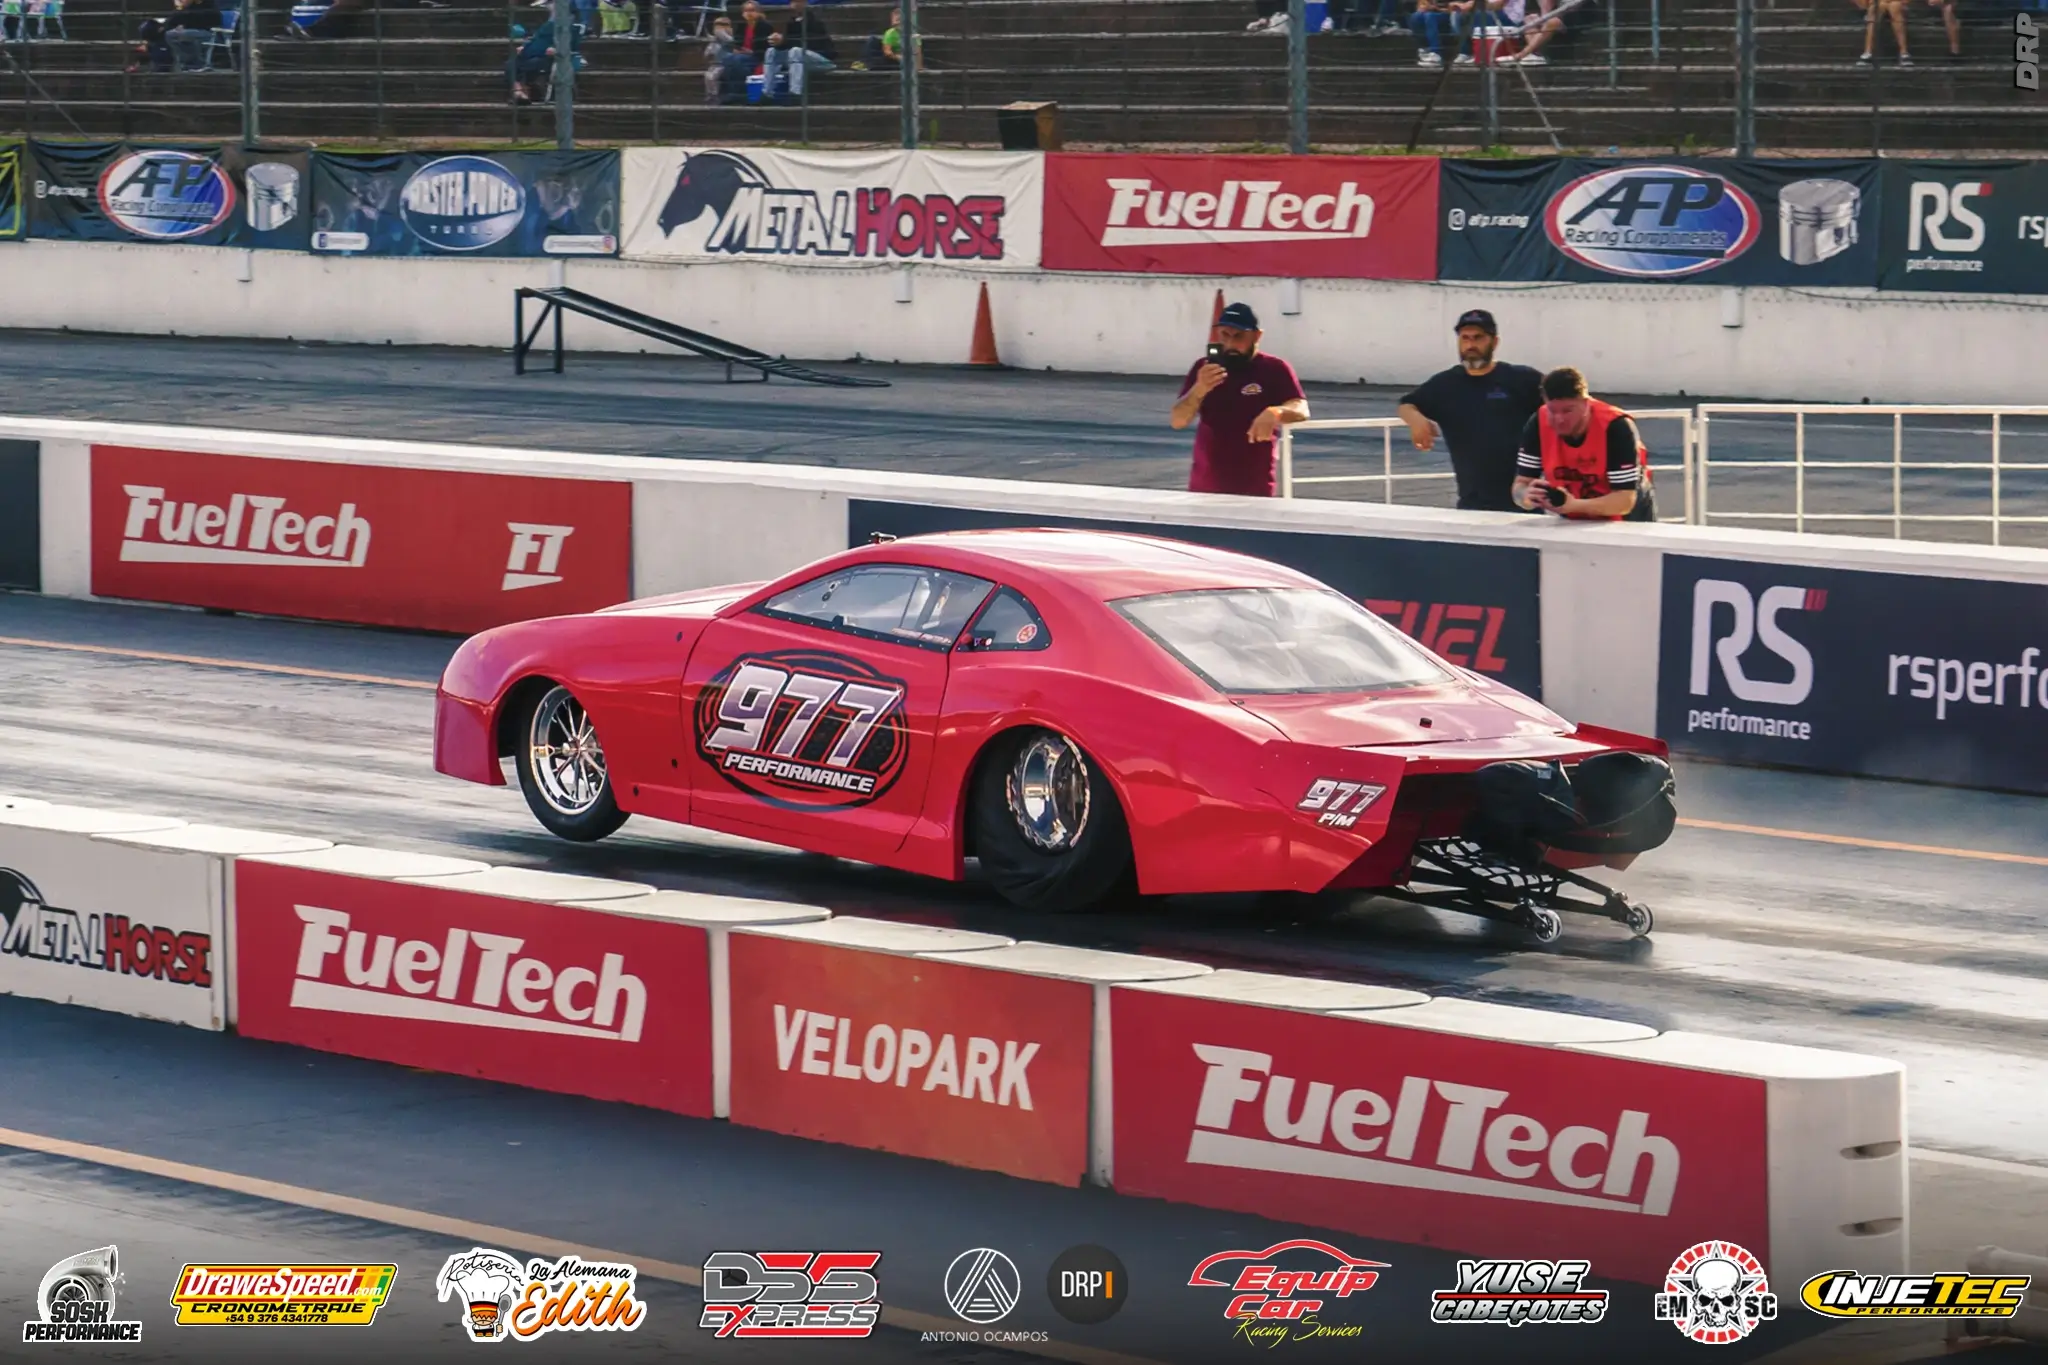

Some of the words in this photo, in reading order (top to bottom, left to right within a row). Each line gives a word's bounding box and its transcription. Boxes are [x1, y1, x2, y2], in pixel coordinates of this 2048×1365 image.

[1102, 178, 1375, 246] FuelTech
[1565, 177, 1726, 227] AFP
[1565, 228, 1619, 246] Racing
[1908, 182, 1993, 252] RS
[120, 484, 371, 567] FuelTech
[1690, 578, 1828, 706] RS
[705, 663, 903, 768] 977
[1688, 707, 1811, 740] performance
[724, 752, 874, 793] PERFORMANCE
[1299, 778, 1387, 814] 977
[290, 904, 647, 1042] FuelTech
[773, 1003, 1041, 1111] VELOPARK
[1187, 1043, 1680, 1216] FuelTech
